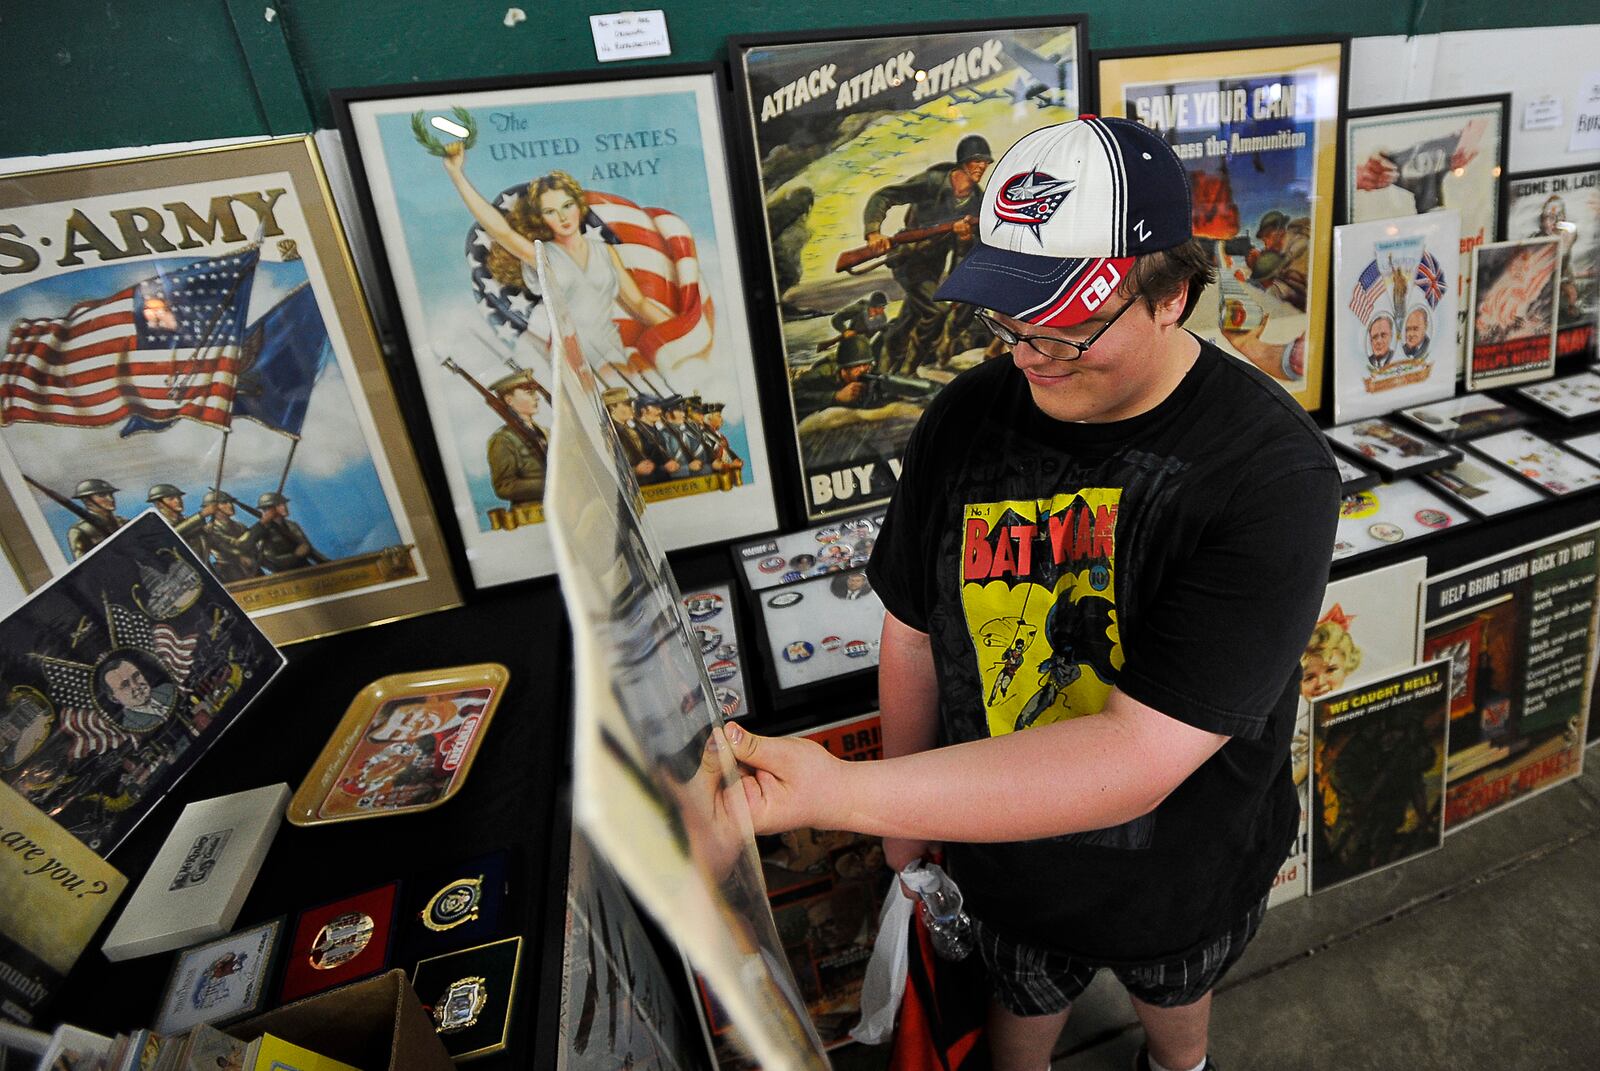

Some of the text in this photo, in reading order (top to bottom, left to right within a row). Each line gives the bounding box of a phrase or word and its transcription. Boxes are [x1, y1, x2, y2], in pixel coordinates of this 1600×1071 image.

[761, 38, 1003, 122] ATTACK ATTACK ATTACK
[489, 112, 528, 133] The
[1136, 94, 1189, 130] SAVE
[1191, 88, 1249, 125] YOUR
[490, 128, 678, 162] UNITED STATES
[1205, 135, 1228, 157] the
[1229, 129, 1307, 154] Ammunition
[591, 158, 661, 181] ARMY
[1574, 173, 1600, 190] LAD
[56, 188, 287, 267] ARMY
[1080, 263, 1121, 312] CBJ
[810, 463, 875, 506] BUY
[1440, 584, 1467, 608] HELP
[1468, 571, 1500, 598] BRING
[1502, 562, 1529, 586] THEM
[1532, 551, 1557, 577] BACK
[1557, 547, 1571, 567] TO
[1329, 700, 1349, 715] WE
[1351, 684, 1401, 708] CAUGHT
[1368, 701, 1391, 714] must
[0, 831, 109, 899] are you?
